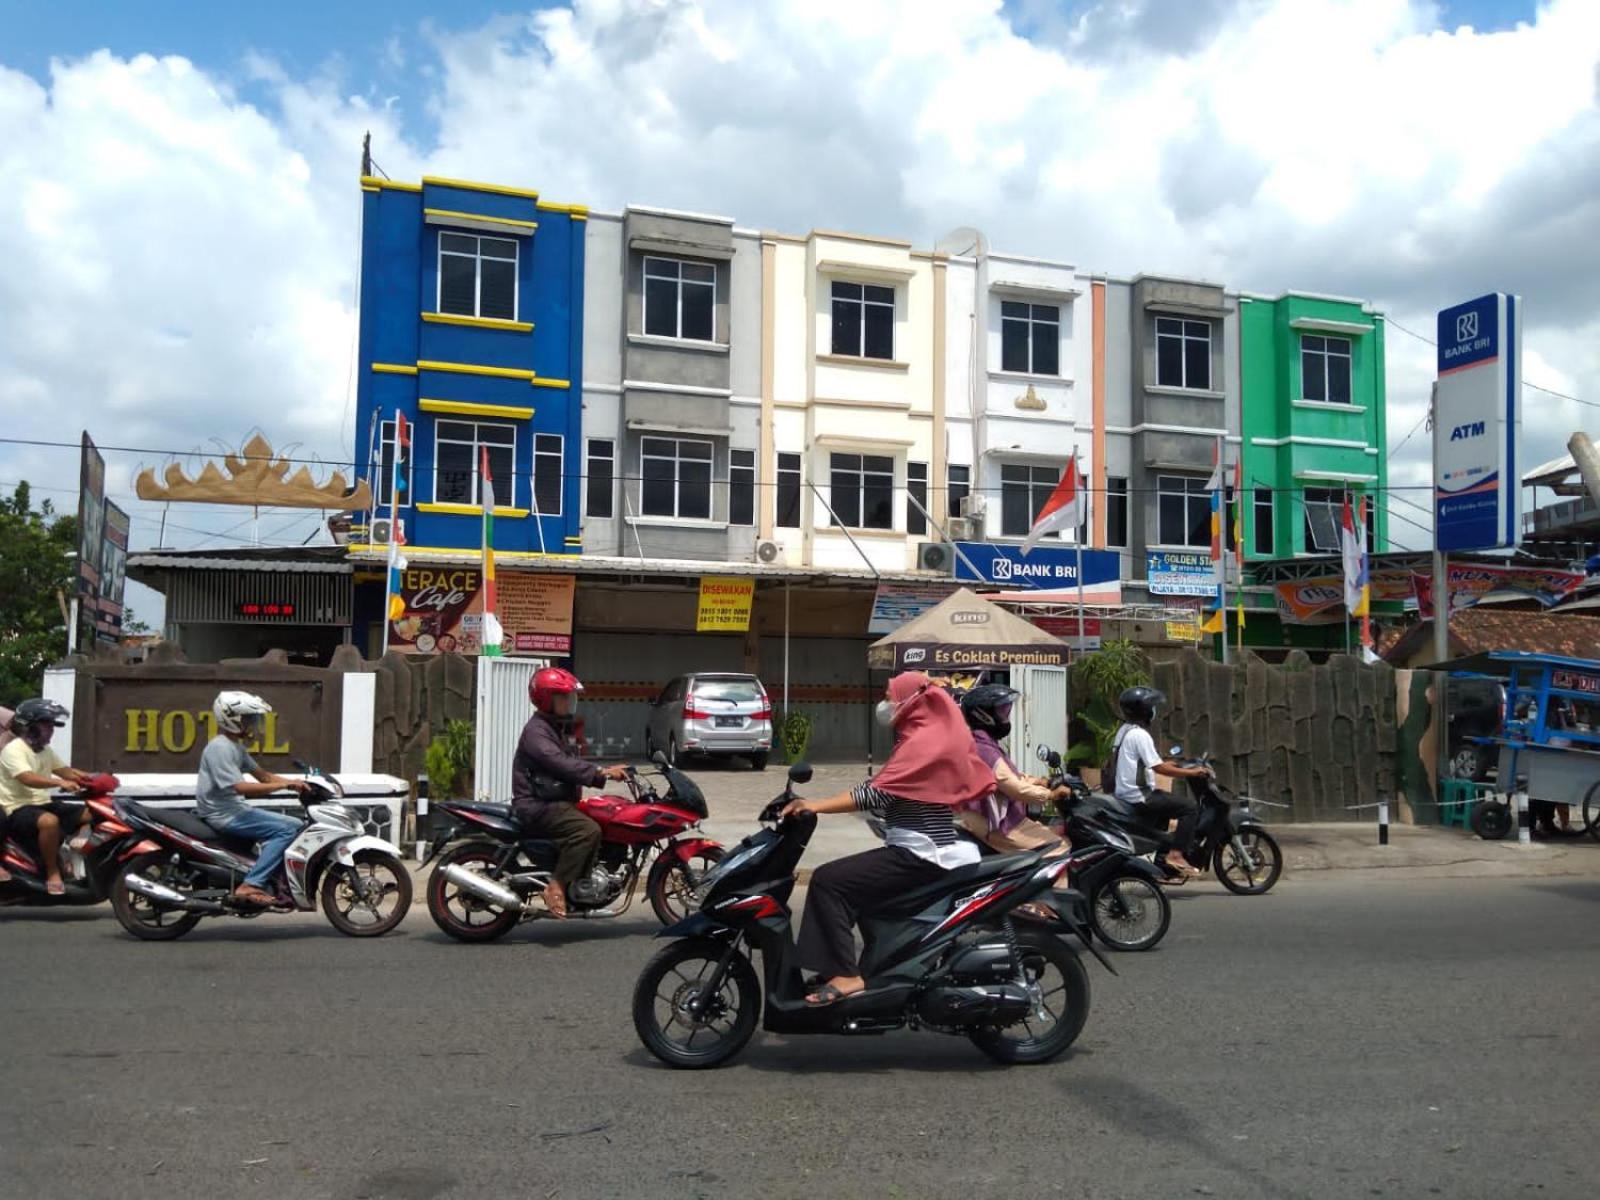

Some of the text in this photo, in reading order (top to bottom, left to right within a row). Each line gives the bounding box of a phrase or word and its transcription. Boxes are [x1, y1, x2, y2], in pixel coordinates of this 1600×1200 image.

[1444, 336, 1490, 359] BANK BRI
[1450, 421, 1484, 441] ATM
[1164, 554, 1197, 565] GOLDEN
[1013, 564, 1077, 578] BANK BRI
[703, 585, 752, 595] DISEWAKAN
[410, 586, 465, 611] Cafe
[953, 612, 987, 623] king
[906, 652, 924, 662] king
[935, 651, 1061, 664] Es Coklat Premium
